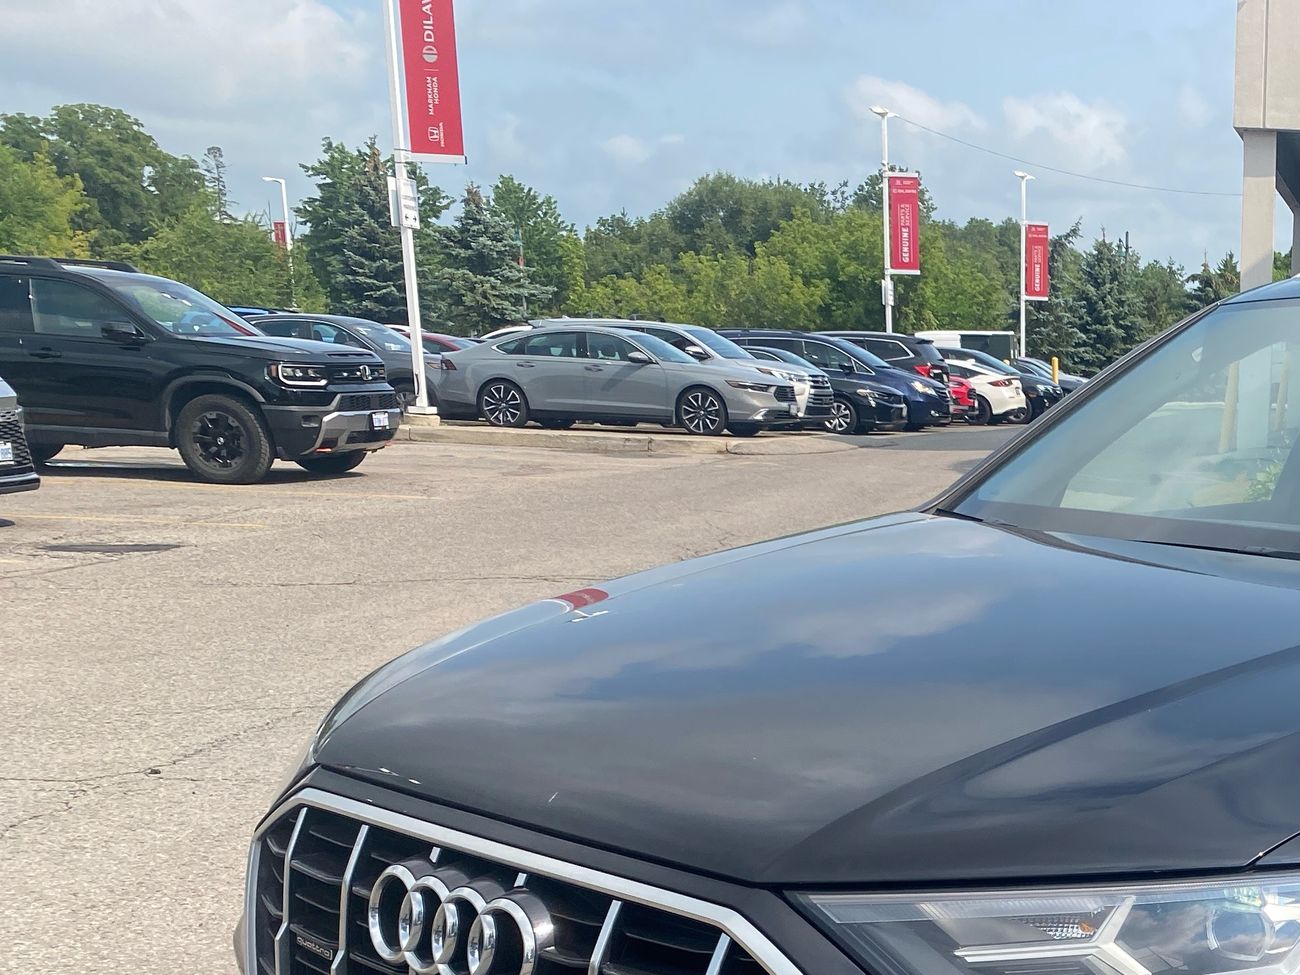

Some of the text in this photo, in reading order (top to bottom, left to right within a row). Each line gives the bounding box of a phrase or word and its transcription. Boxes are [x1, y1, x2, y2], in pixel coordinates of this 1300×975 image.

[421, 0, 435, 42] DILA
[426, 76, 435, 116] MARKHAM
[432, 76, 440, 105] HONDA
[902, 227, 910, 263] GENUINE
[296, 936, 330, 957] quattro
